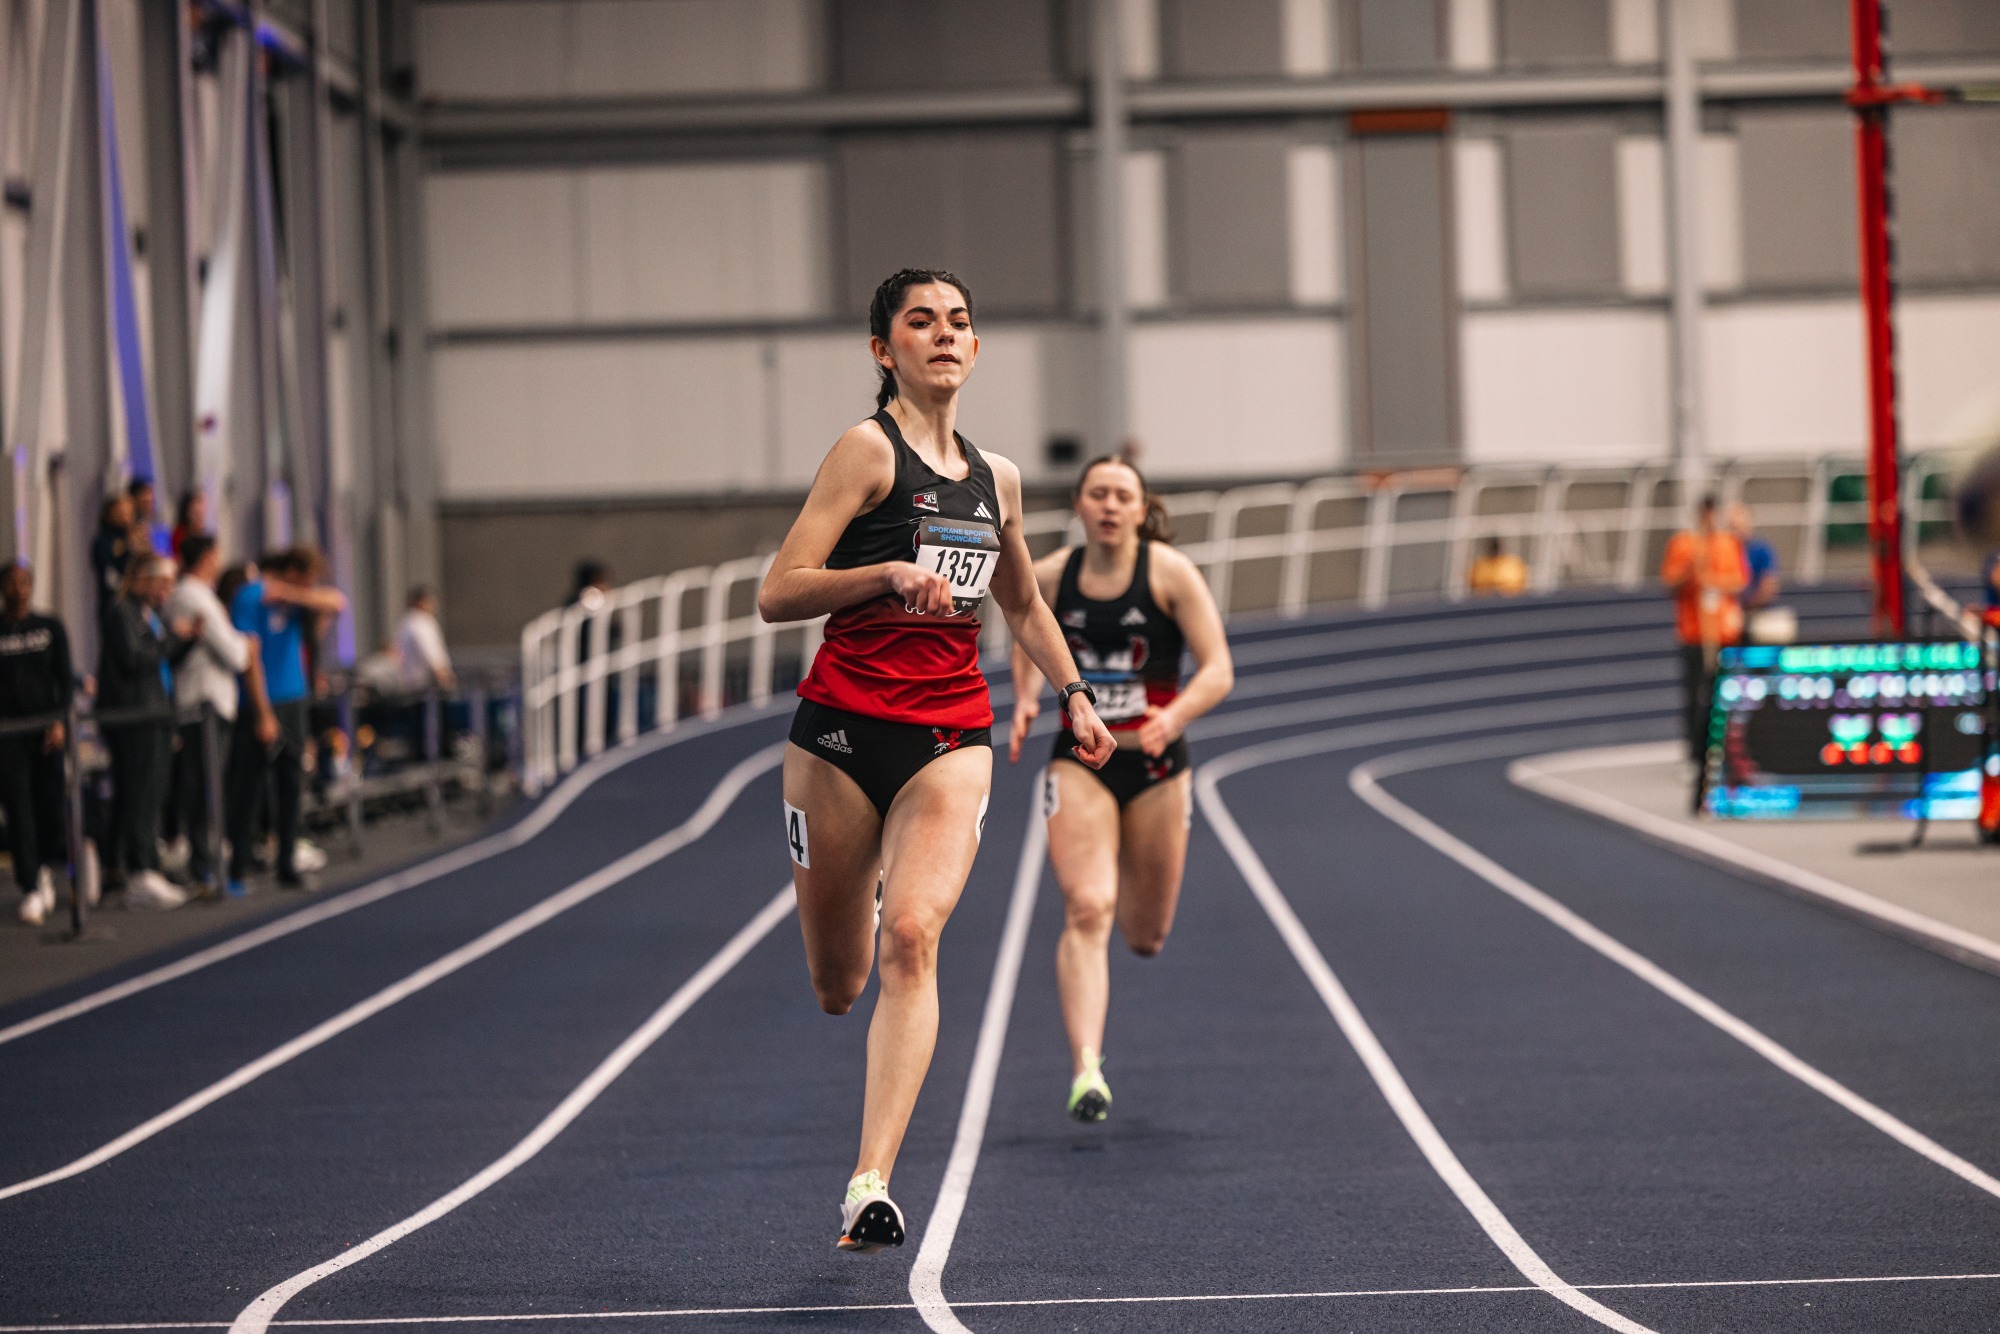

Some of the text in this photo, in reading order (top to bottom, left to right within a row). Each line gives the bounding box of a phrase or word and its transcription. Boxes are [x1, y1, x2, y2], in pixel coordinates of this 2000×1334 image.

[923, 493, 937, 504] SKY
[928, 525, 992, 539] SPOKANE SPORTS
[941, 533, 982, 544] SHOWCASE
[935, 549, 987, 587] 1357
[817, 736, 853, 754] adidas
[790, 811, 804, 863] 4
